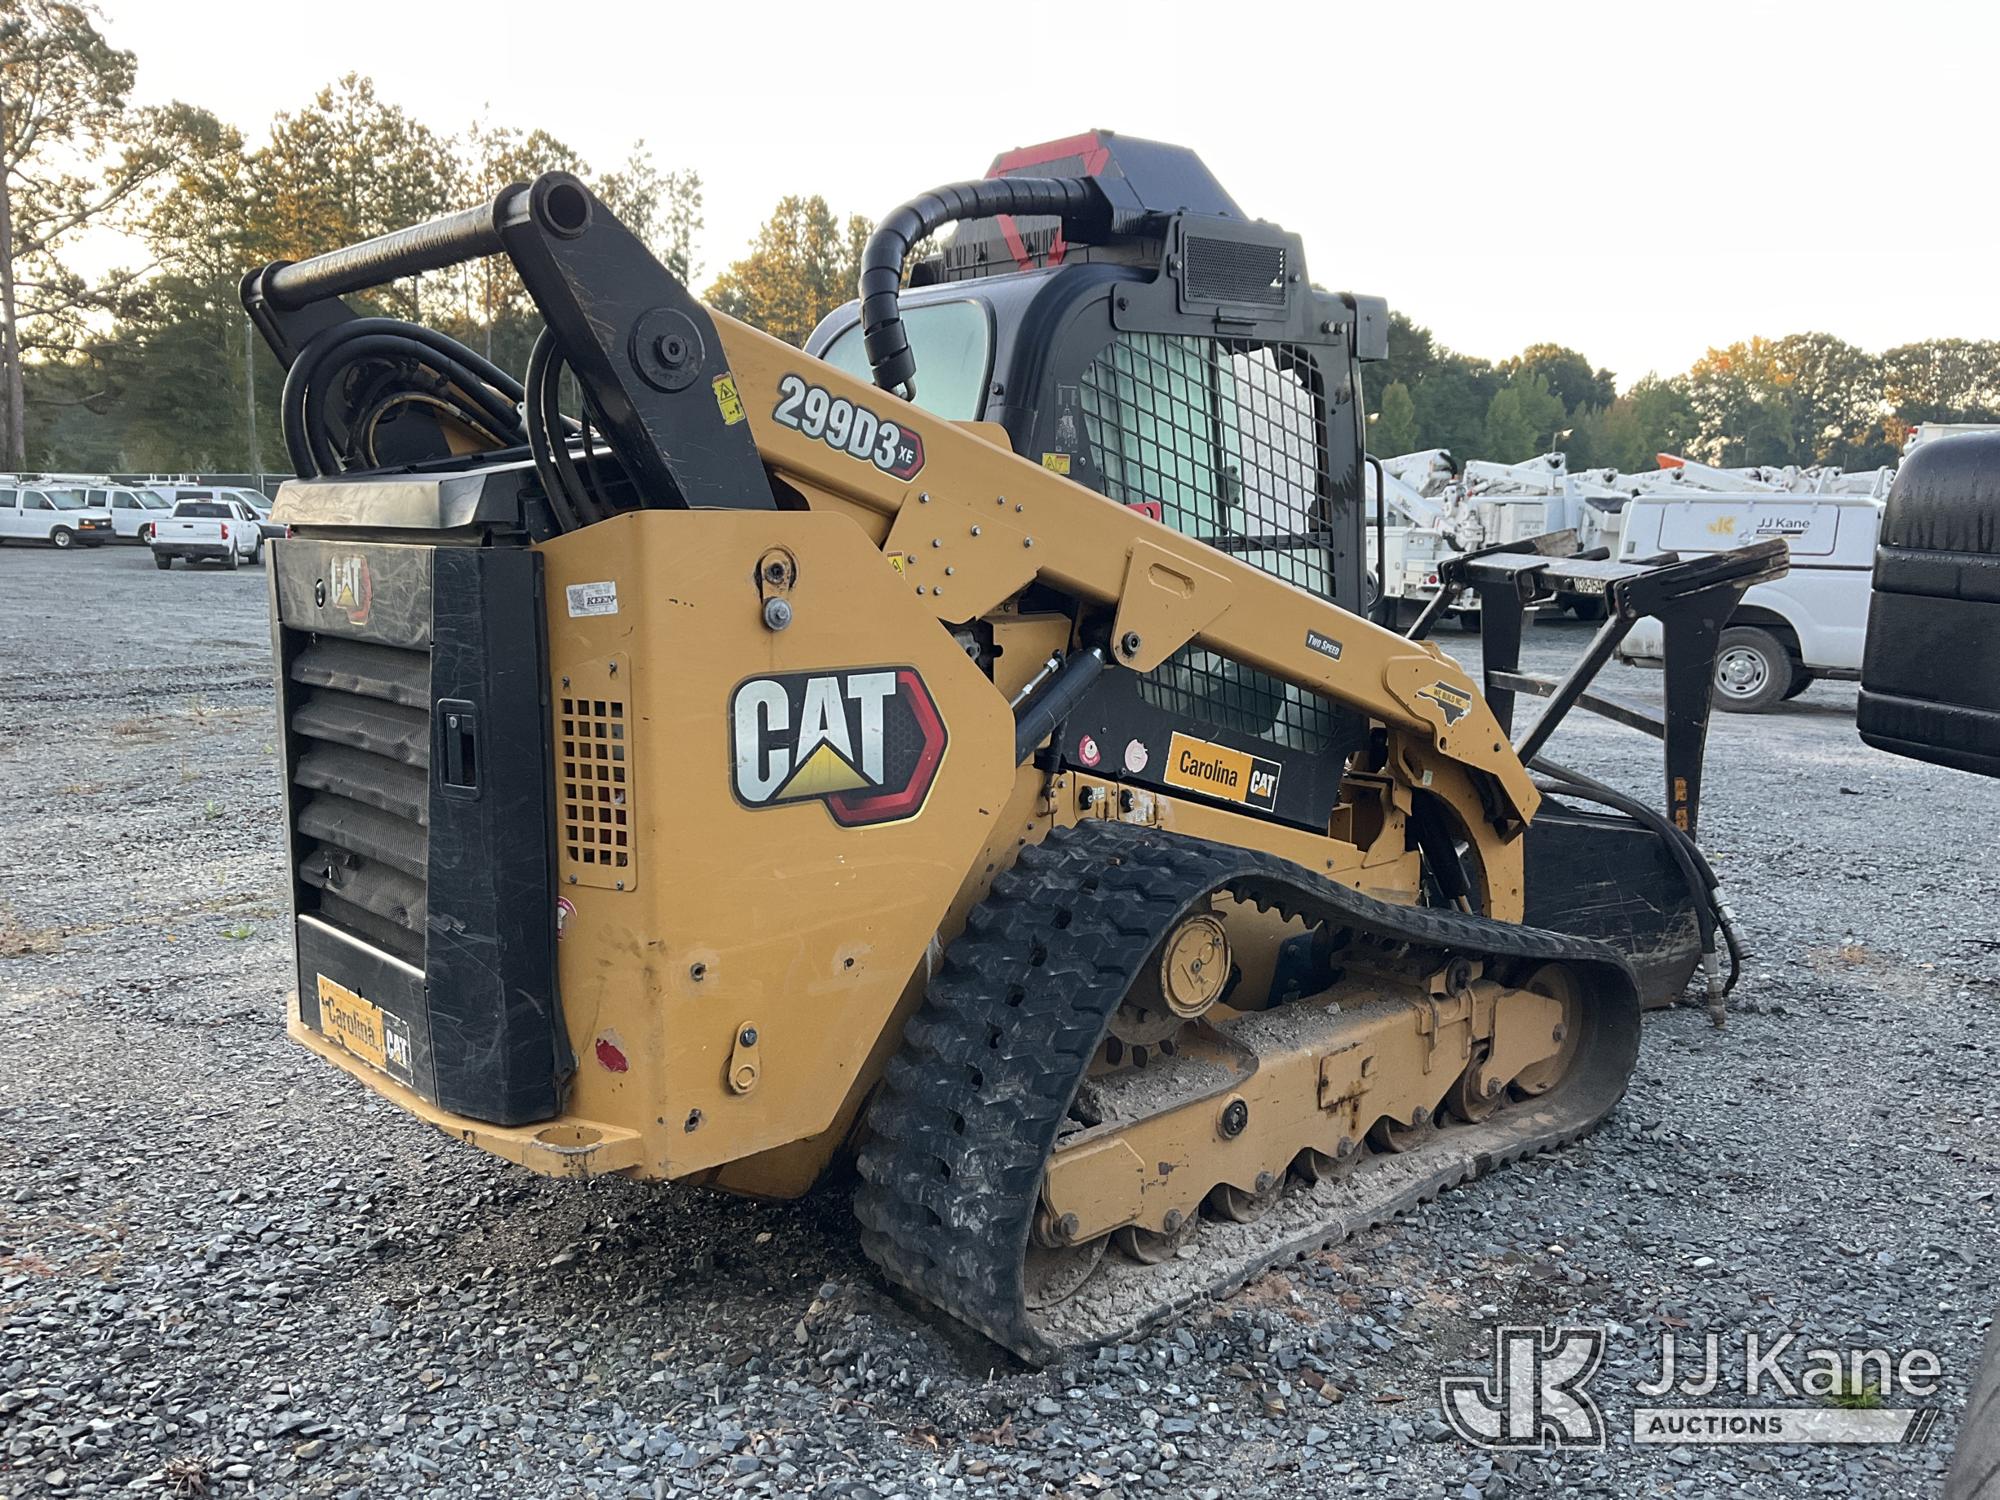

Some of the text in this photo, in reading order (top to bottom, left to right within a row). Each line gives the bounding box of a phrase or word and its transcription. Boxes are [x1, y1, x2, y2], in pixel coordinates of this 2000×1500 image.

[774, 375, 915, 470] 299D3 XE
[1757, 517, 1811, 529] JJ Kane
[331, 556, 362, 608] CAT
[734, 671, 896, 803] CAT
[1179, 749, 1276, 799] Carolina CAT
[327, 995, 407, 1067] Carolina CAT
